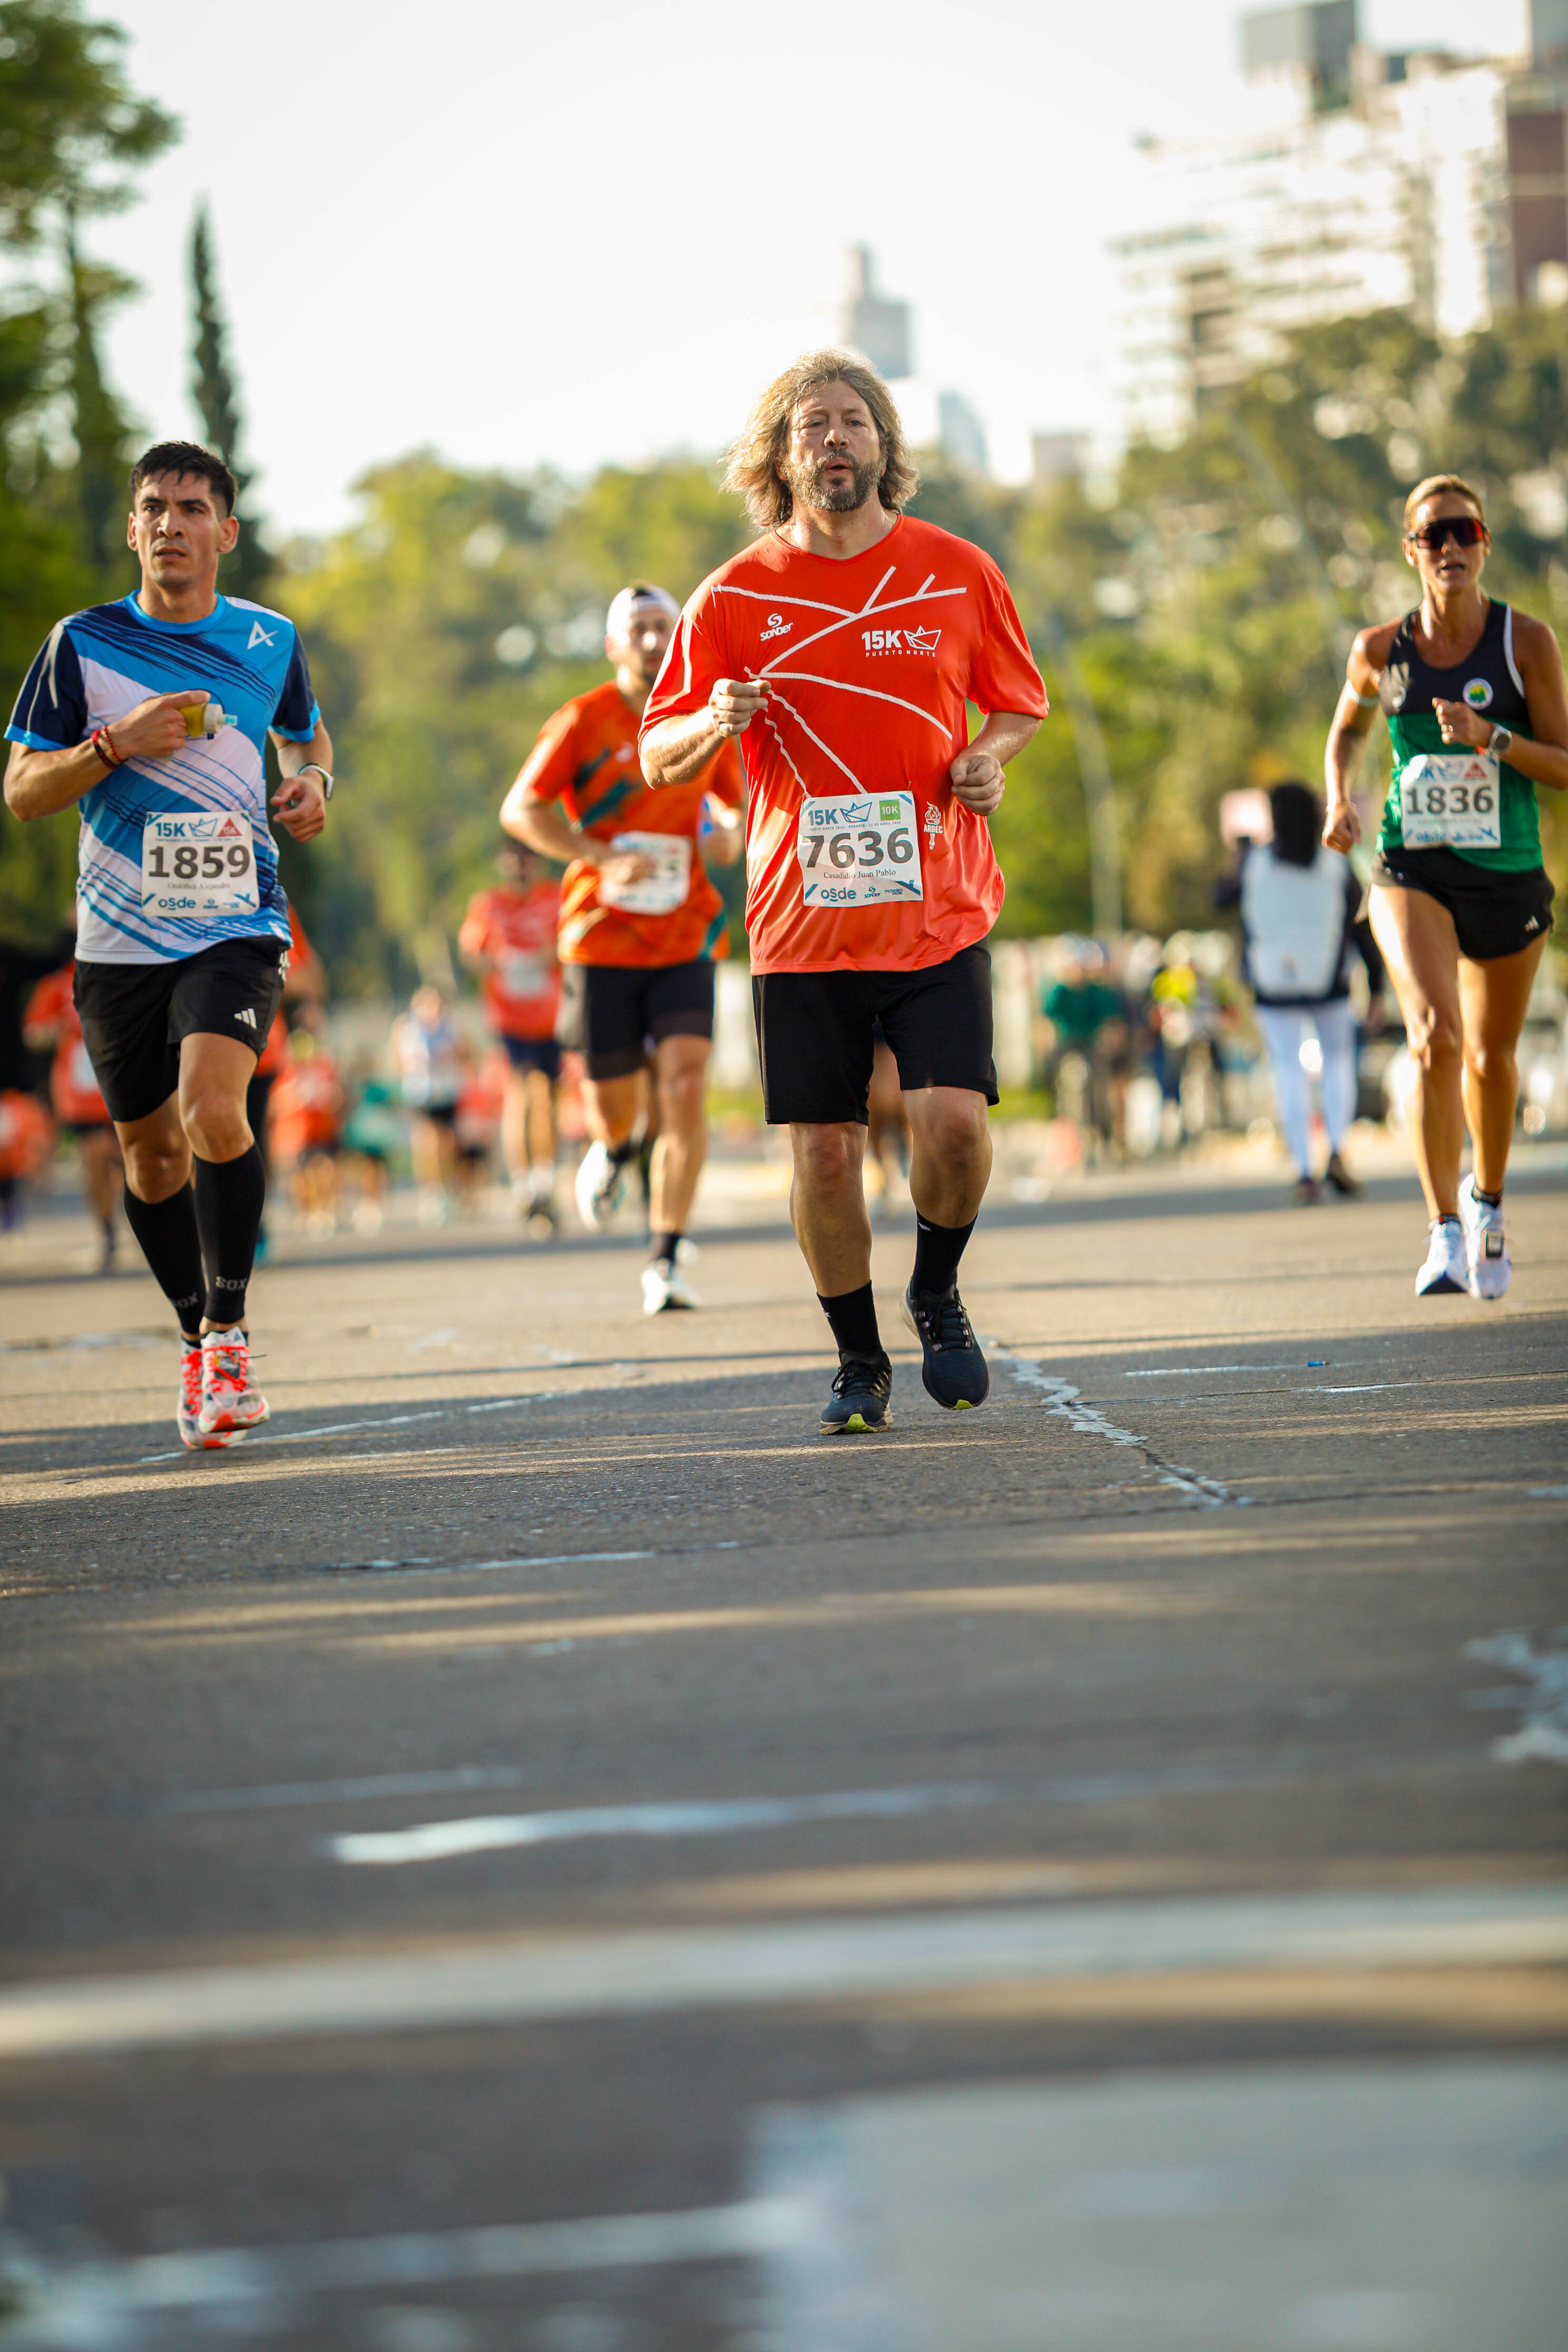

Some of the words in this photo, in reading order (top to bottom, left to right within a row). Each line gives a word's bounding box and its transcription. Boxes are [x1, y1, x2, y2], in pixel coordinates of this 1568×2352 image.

[861, 630, 903, 651] 15K
[1406, 785, 1493, 815] 1836
[881, 804, 898, 815] 10K
[808, 809, 839, 826] 15K
[155, 822, 186, 837] 15K
[924, 824, 943, 834] ARDEC
[803, 828, 914, 868] 7636
[148, 845, 250, 879] 1859
[824, 870, 856, 879] Casadidio
[858, 869, 874, 878] Juan
[821, 887, 857, 901] osde
[158, 896, 195, 910] osde
